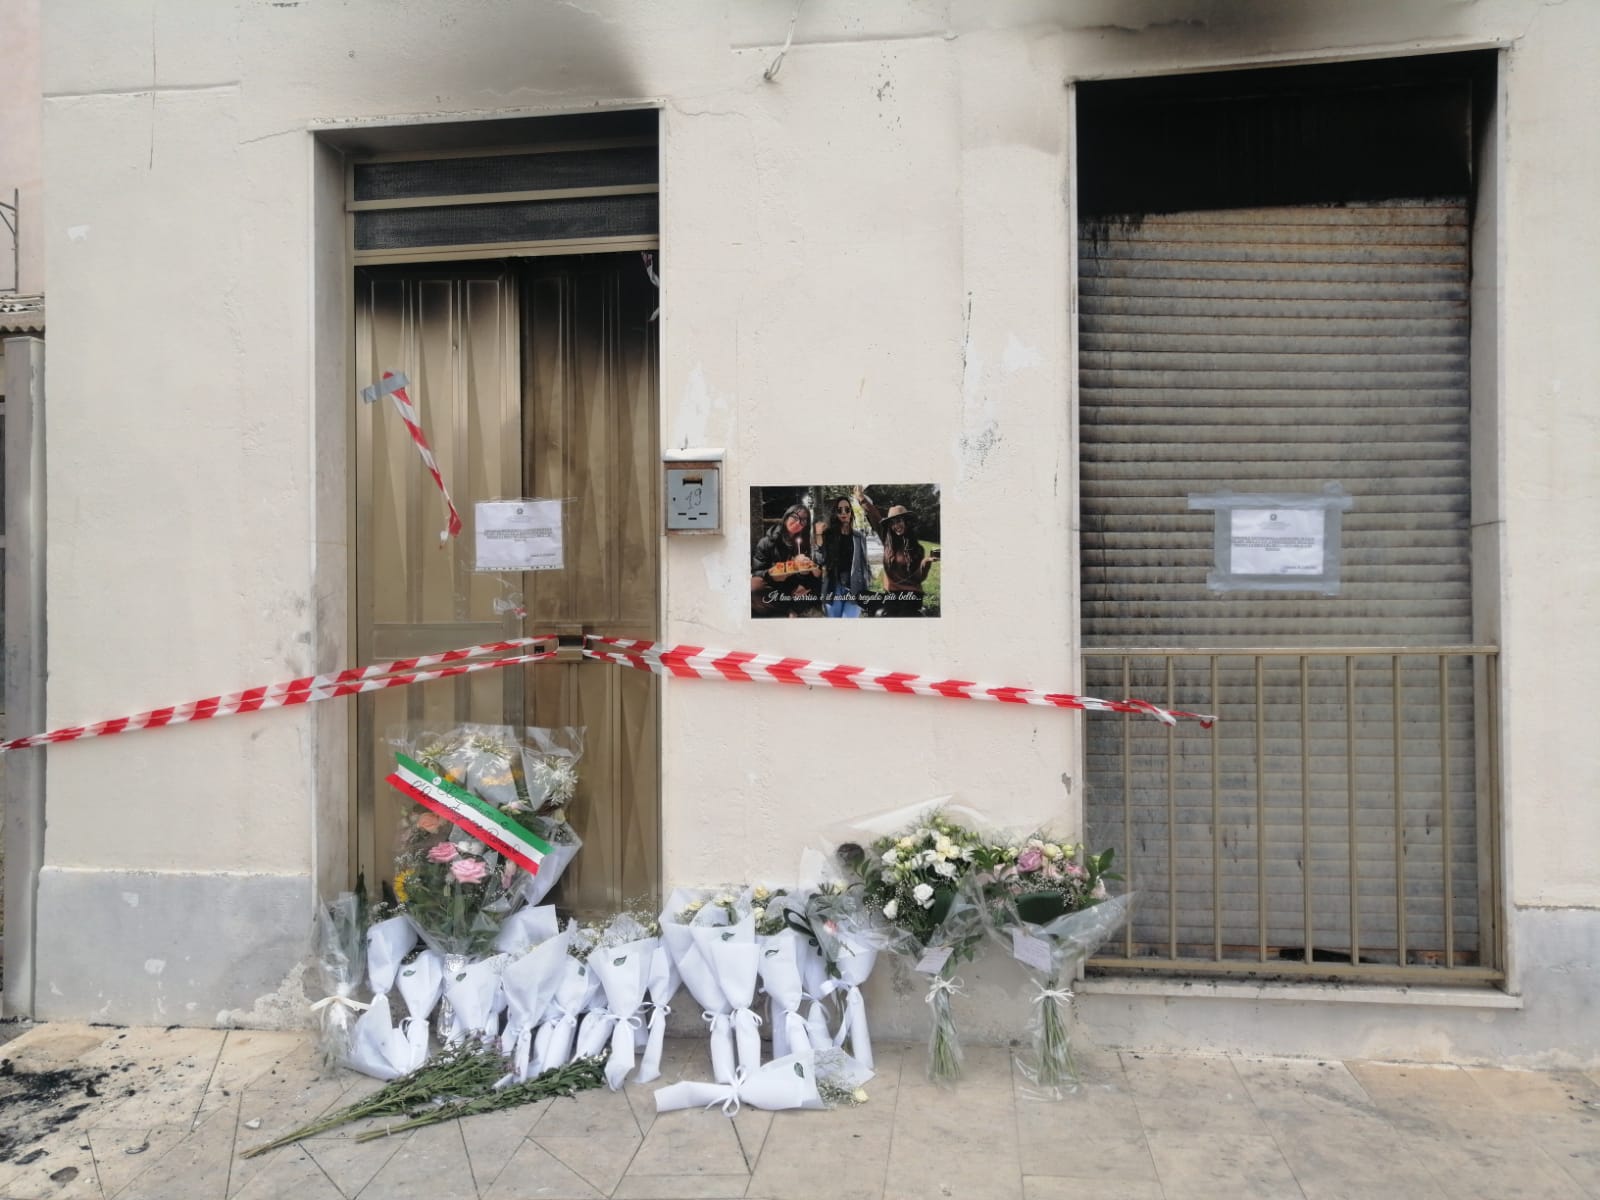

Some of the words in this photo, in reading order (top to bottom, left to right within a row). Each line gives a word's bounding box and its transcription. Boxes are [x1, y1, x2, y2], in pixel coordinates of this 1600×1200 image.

[685, 488, 702, 509] 19
[762, 590, 779, 604] Il
[780, 592, 792, 601] tuo
[792, 593, 818, 602] sorriso
[826, 591, 834, 601] il
[834, 591, 856, 601] nostro
[858, 591, 882, 605] regalo
[882, 592, 897, 604] più
